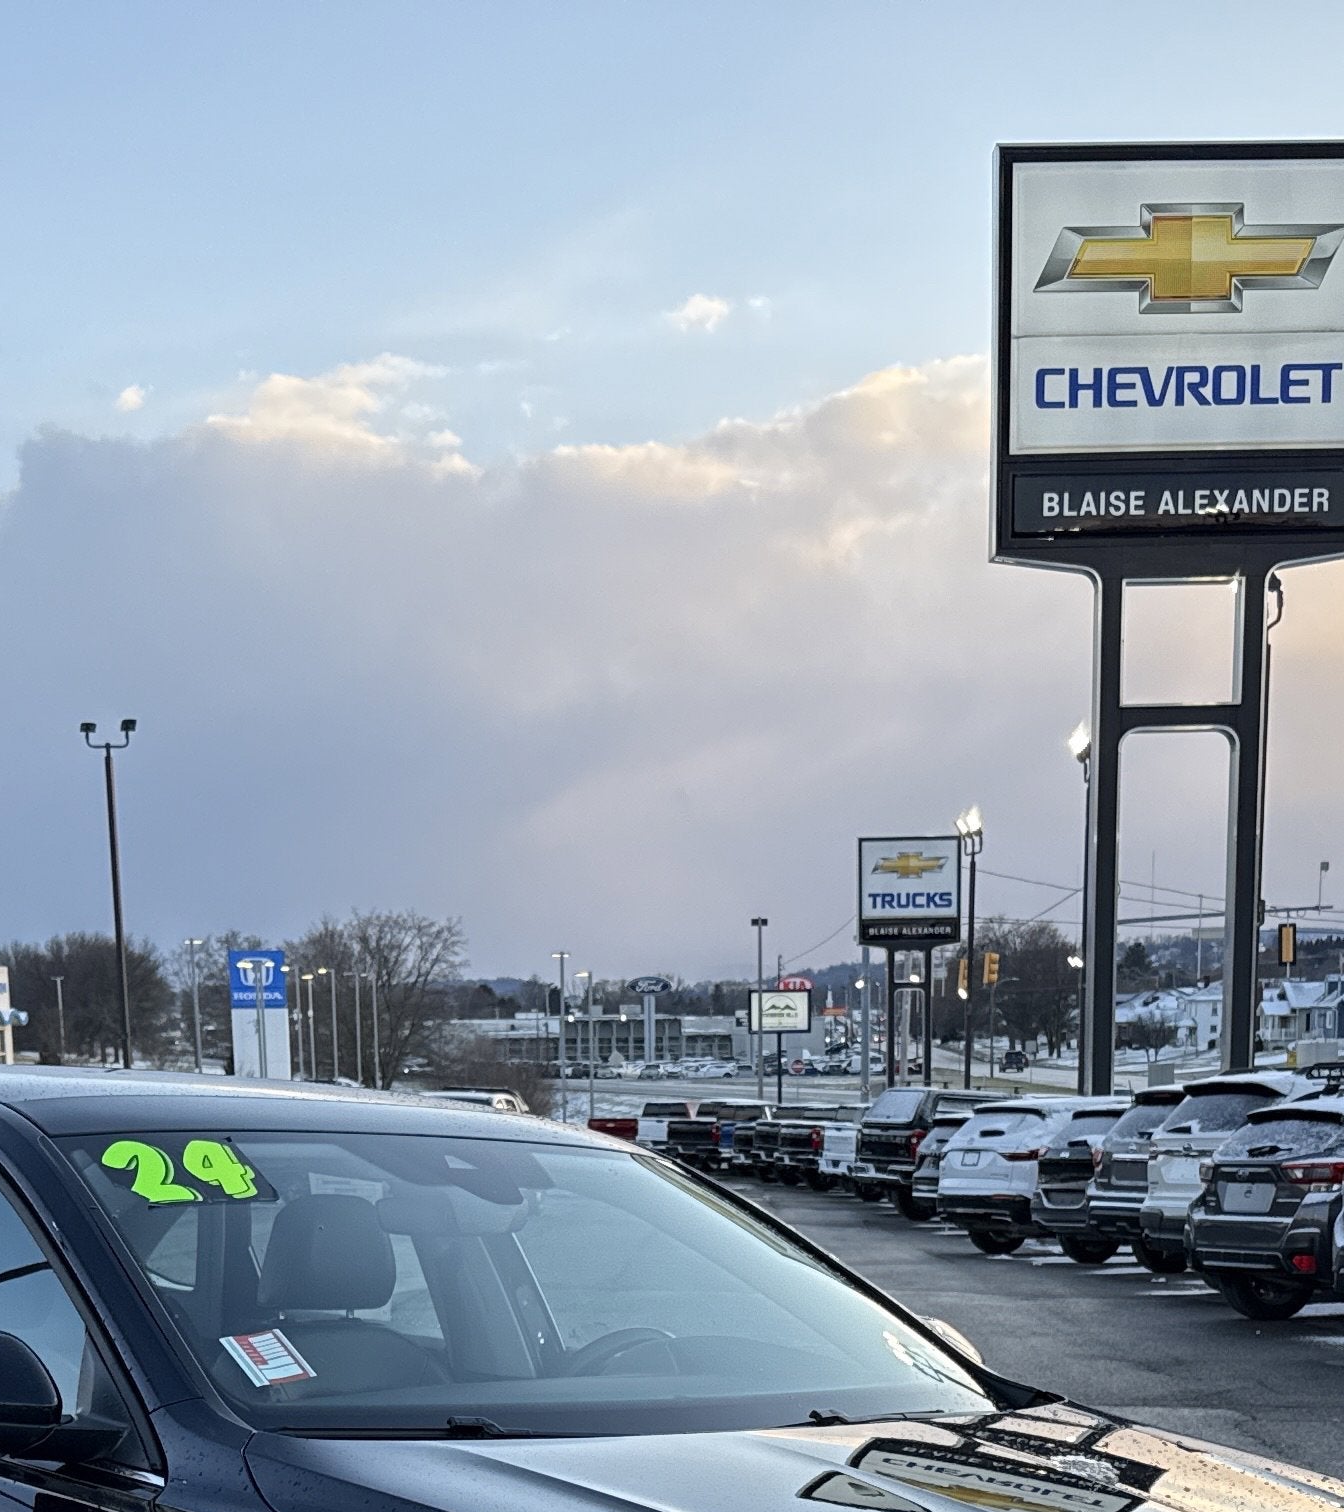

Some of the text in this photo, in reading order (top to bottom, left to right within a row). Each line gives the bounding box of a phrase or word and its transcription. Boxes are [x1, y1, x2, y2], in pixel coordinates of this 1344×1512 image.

[1035, 362, 1343, 409] CHEVROLET
[1042, 488, 1330, 517] BLAISE ALEXANDER
[868, 892, 953, 909] TRUCKS
[868, 926, 952, 936] BLAISE ALEXANDER
[233, 992, 283, 1000] HODA
[102, 1140, 258, 1203] 24
